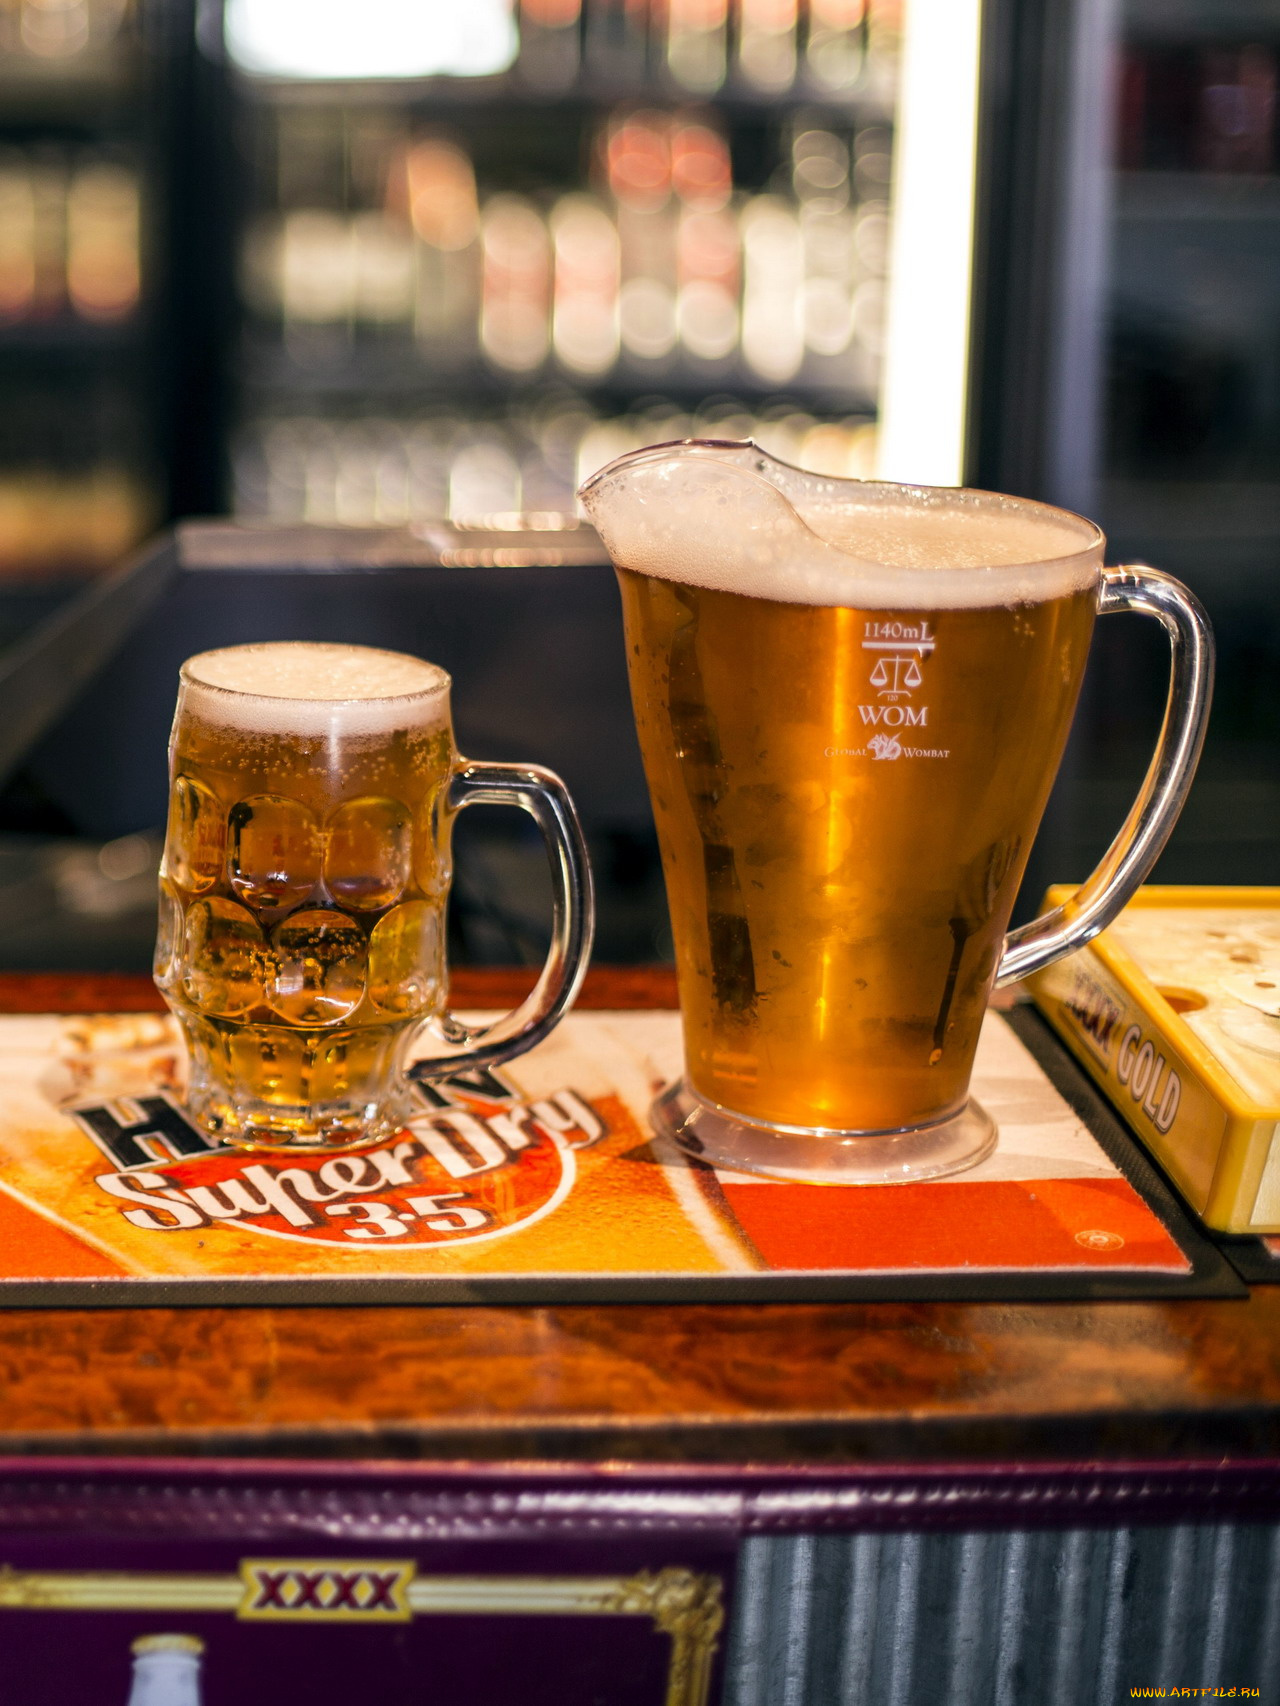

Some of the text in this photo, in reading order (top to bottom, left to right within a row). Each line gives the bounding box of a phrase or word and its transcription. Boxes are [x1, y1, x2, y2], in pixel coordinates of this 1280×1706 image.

[864, 622, 934, 641] 1140mL
[858, 705, 928, 726] WOM
[1117, 1024, 1181, 1135] GOLD
[253, 1569, 402, 1611] XXXX
